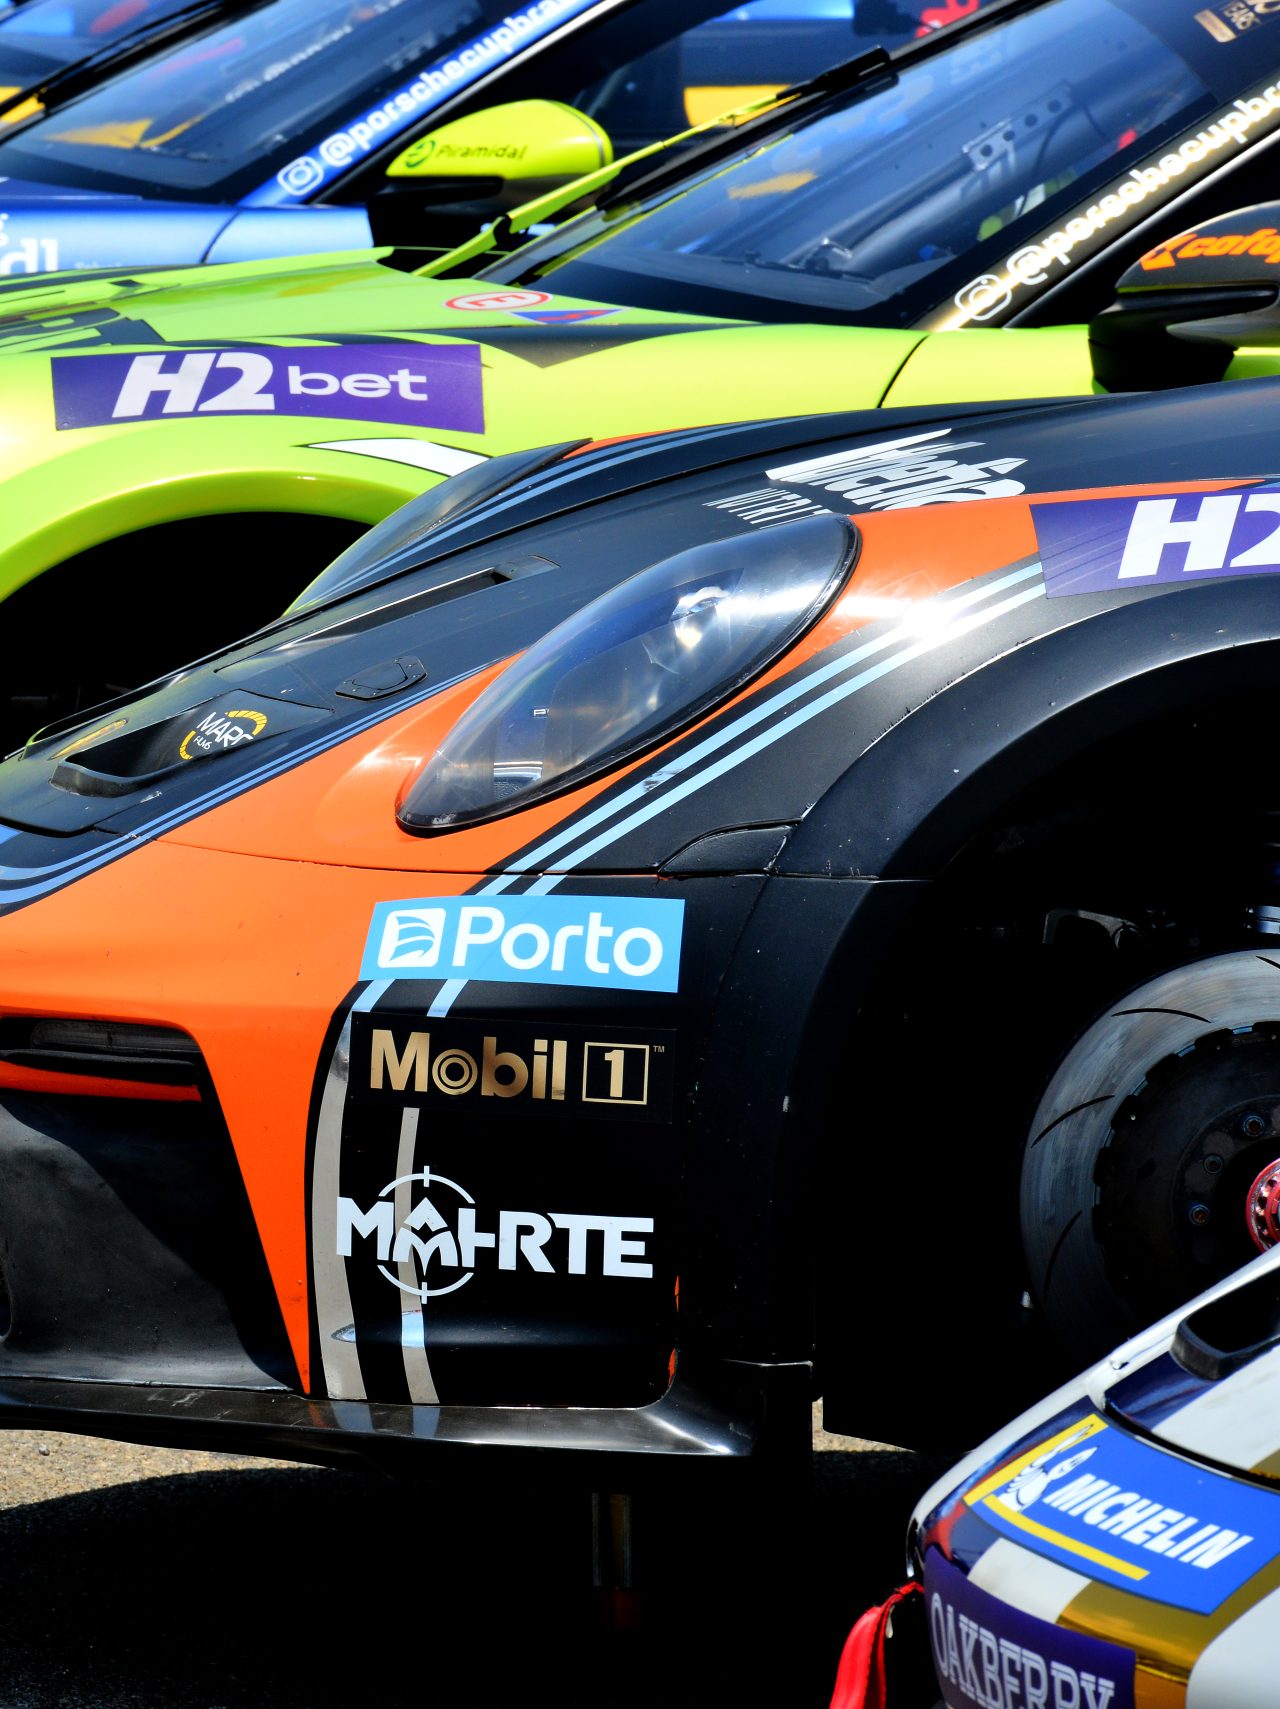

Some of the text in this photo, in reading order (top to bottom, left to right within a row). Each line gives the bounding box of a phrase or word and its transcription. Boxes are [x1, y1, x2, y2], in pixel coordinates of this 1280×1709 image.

[438, 144, 528, 162] Piramidal
[112, 352, 429, 419] H2 bet
[452, 906, 664, 977] Porto
[369, 1029, 568, 1101] Mobil
[603, 1049, 624, 1098] 1
[1042, 1473, 1255, 1570] MICHELIN
